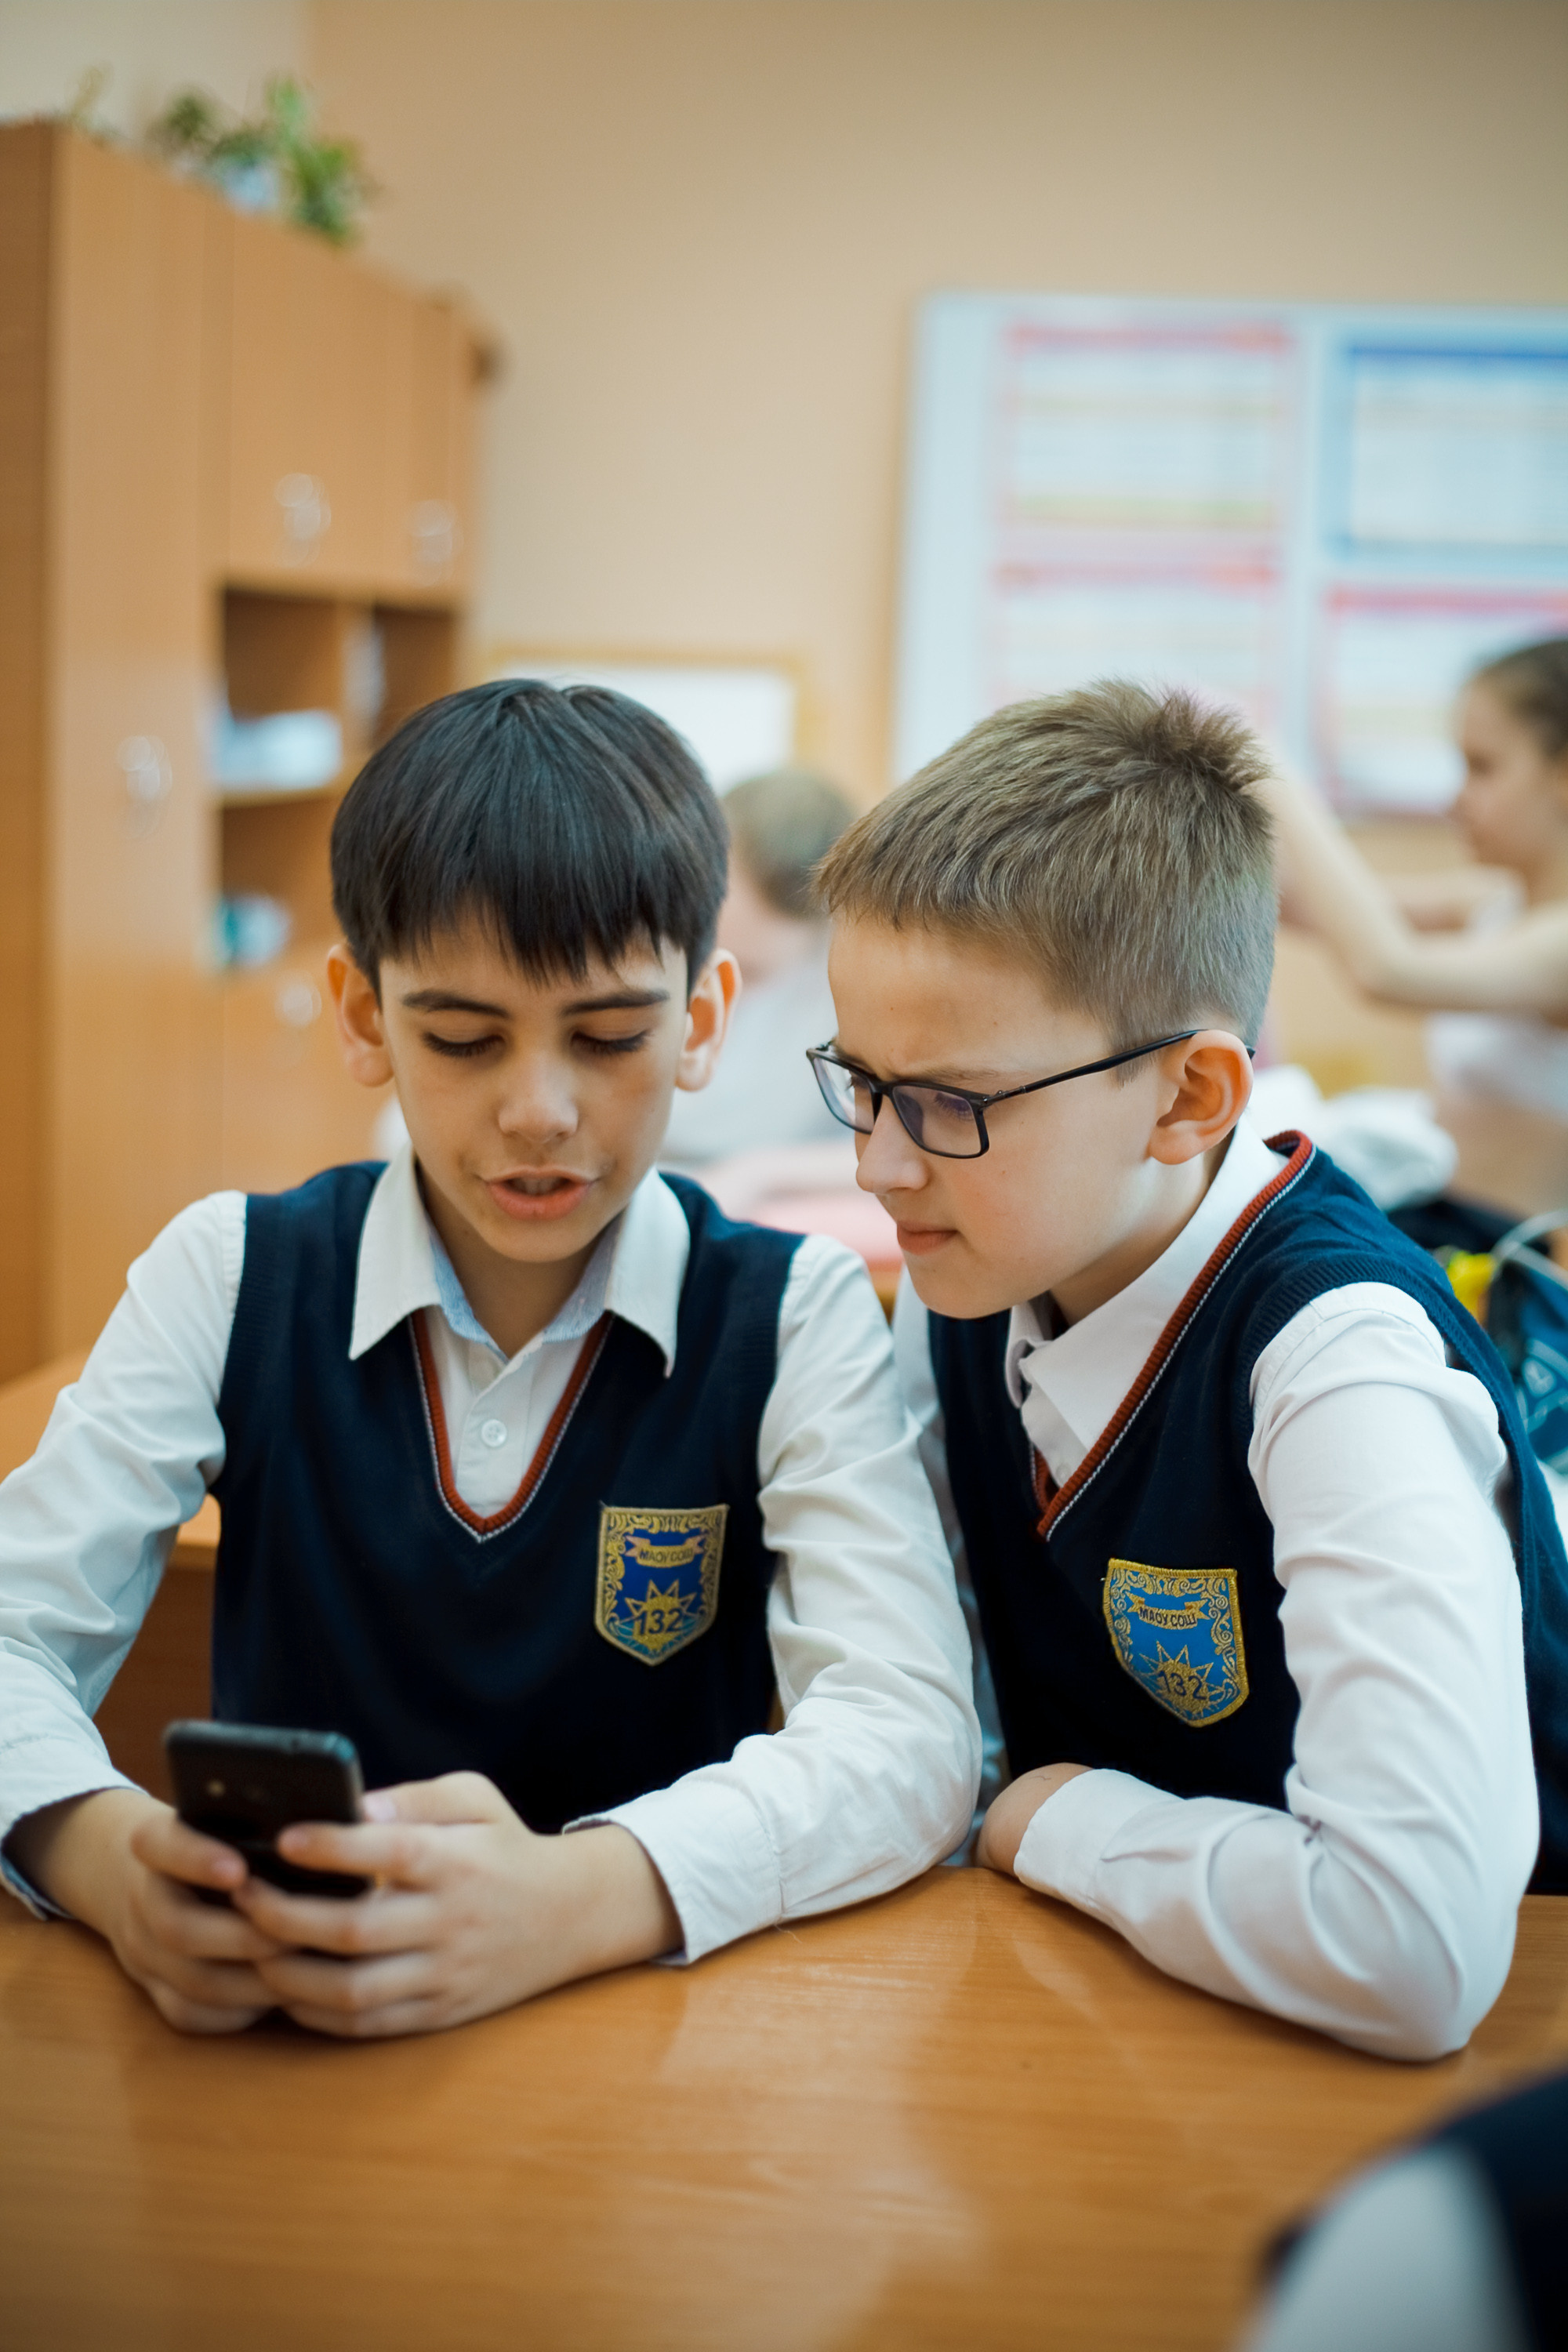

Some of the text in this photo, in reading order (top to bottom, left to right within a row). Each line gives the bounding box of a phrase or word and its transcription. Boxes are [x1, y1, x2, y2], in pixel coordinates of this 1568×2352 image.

[638, 1608, 684, 1635] 132
[1140, 1606, 1196, 1627] МАОУ СОШ
[1157, 1670, 1207, 1700] 132
